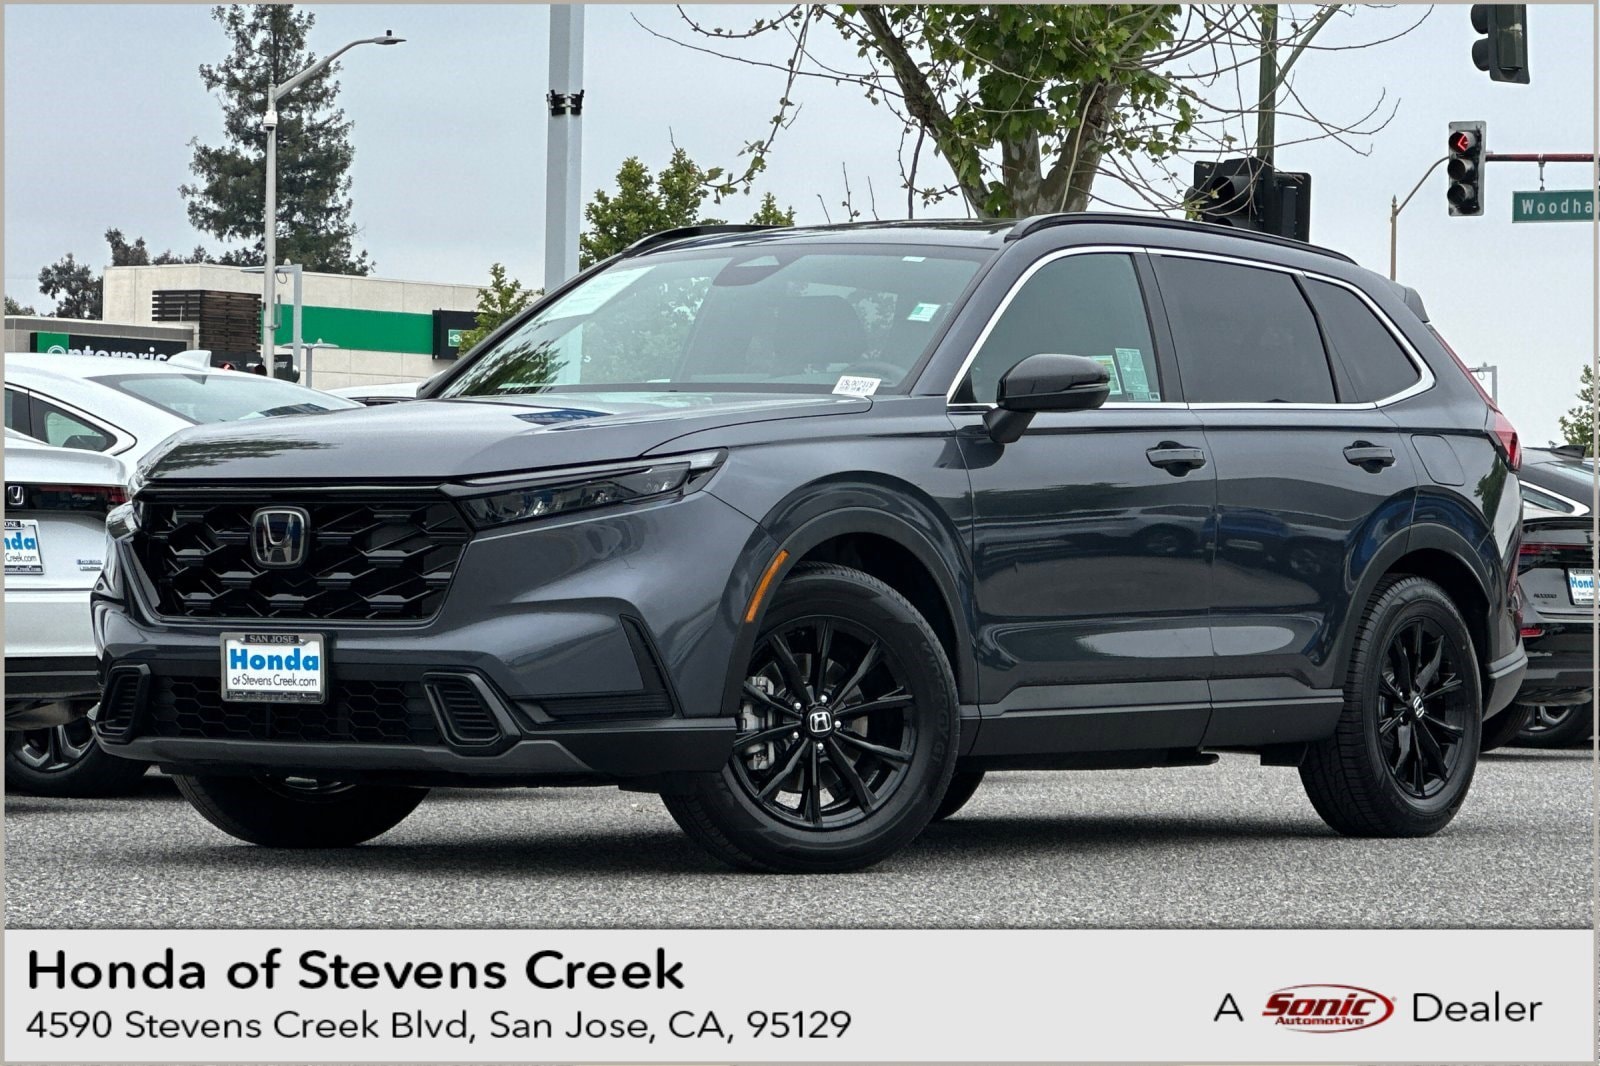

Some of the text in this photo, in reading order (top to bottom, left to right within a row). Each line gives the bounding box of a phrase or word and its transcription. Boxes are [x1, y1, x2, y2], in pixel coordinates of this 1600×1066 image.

[1521, 198, 1594, 215] Woodha
[249, 634, 295, 644] SAN JOSE
[230, 647, 319, 671] Honda
[232, 673, 318, 687] of Stevens Creek.com
